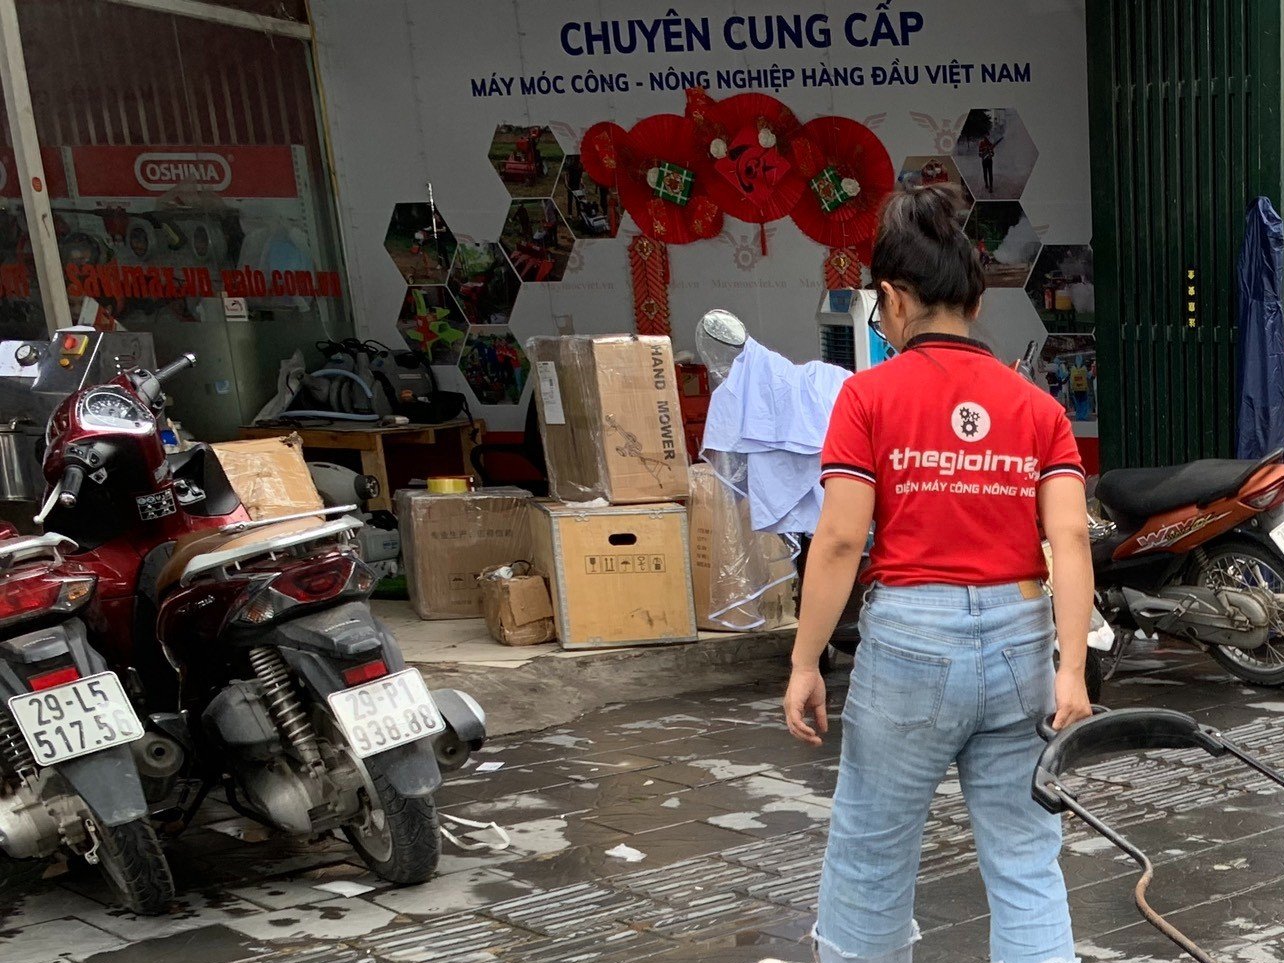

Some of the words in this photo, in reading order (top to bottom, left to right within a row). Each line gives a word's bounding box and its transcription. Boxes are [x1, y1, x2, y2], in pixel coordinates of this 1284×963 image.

[560, 9, 711, 56] CHUYÊN
[723, 13, 832, 50] CUNG
[844, 0, 924, 47] CẤP
[471, 73, 514, 97] MÁY
[520, 71, 565, 95] MÓC
[571, 69, 629, 93] CÔNG
[650, 67, 710, 91] NÔNG
[717, 64, 795, 92] NGHIỆP
[802, 62, 864, 87] HÀNG
[871, 58, 919, 86] ĐẦU
[925, 59, 975, 89] VIỆT
[981, 63, 1031, 83] NAM
[146, 163, 219, 181] OSHIMA
[651, 346, 667, 390] HAND
[657, 401, 675, 460] MOWER
[921, 479, 947, 492] MÁY
[950, 481, 979, 494] CÔNG
[982, 482, 1017, 496] NÔNG
[29, 681, 109, 726] 29-L5
[345, 678, 416, 720] 29-P1
[34, 709, 133, 758] 517.56
[353, 704, 436, 751] 938.88
